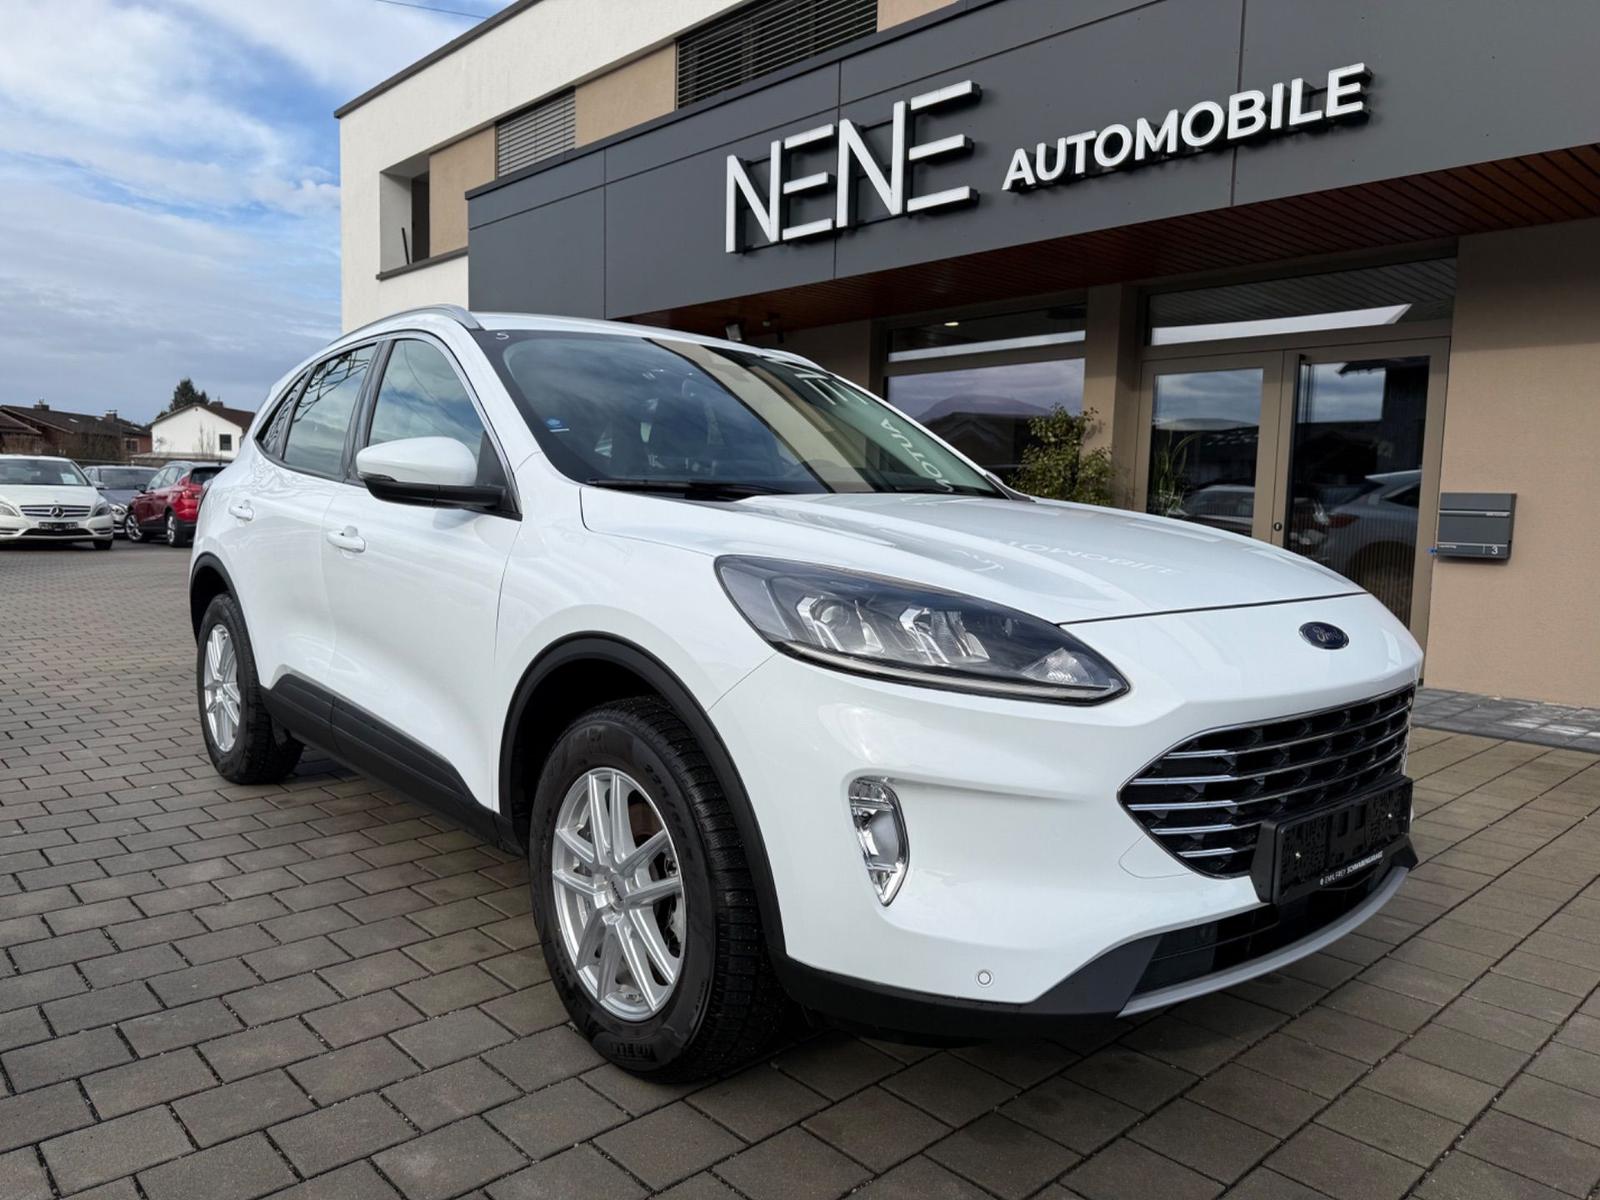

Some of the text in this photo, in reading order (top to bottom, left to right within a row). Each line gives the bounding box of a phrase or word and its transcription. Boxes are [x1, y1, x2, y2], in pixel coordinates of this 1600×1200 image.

[725, 61, 1370, 254] NENE AUTOMOBILE
[1491, 545, 1499, 555] 3
